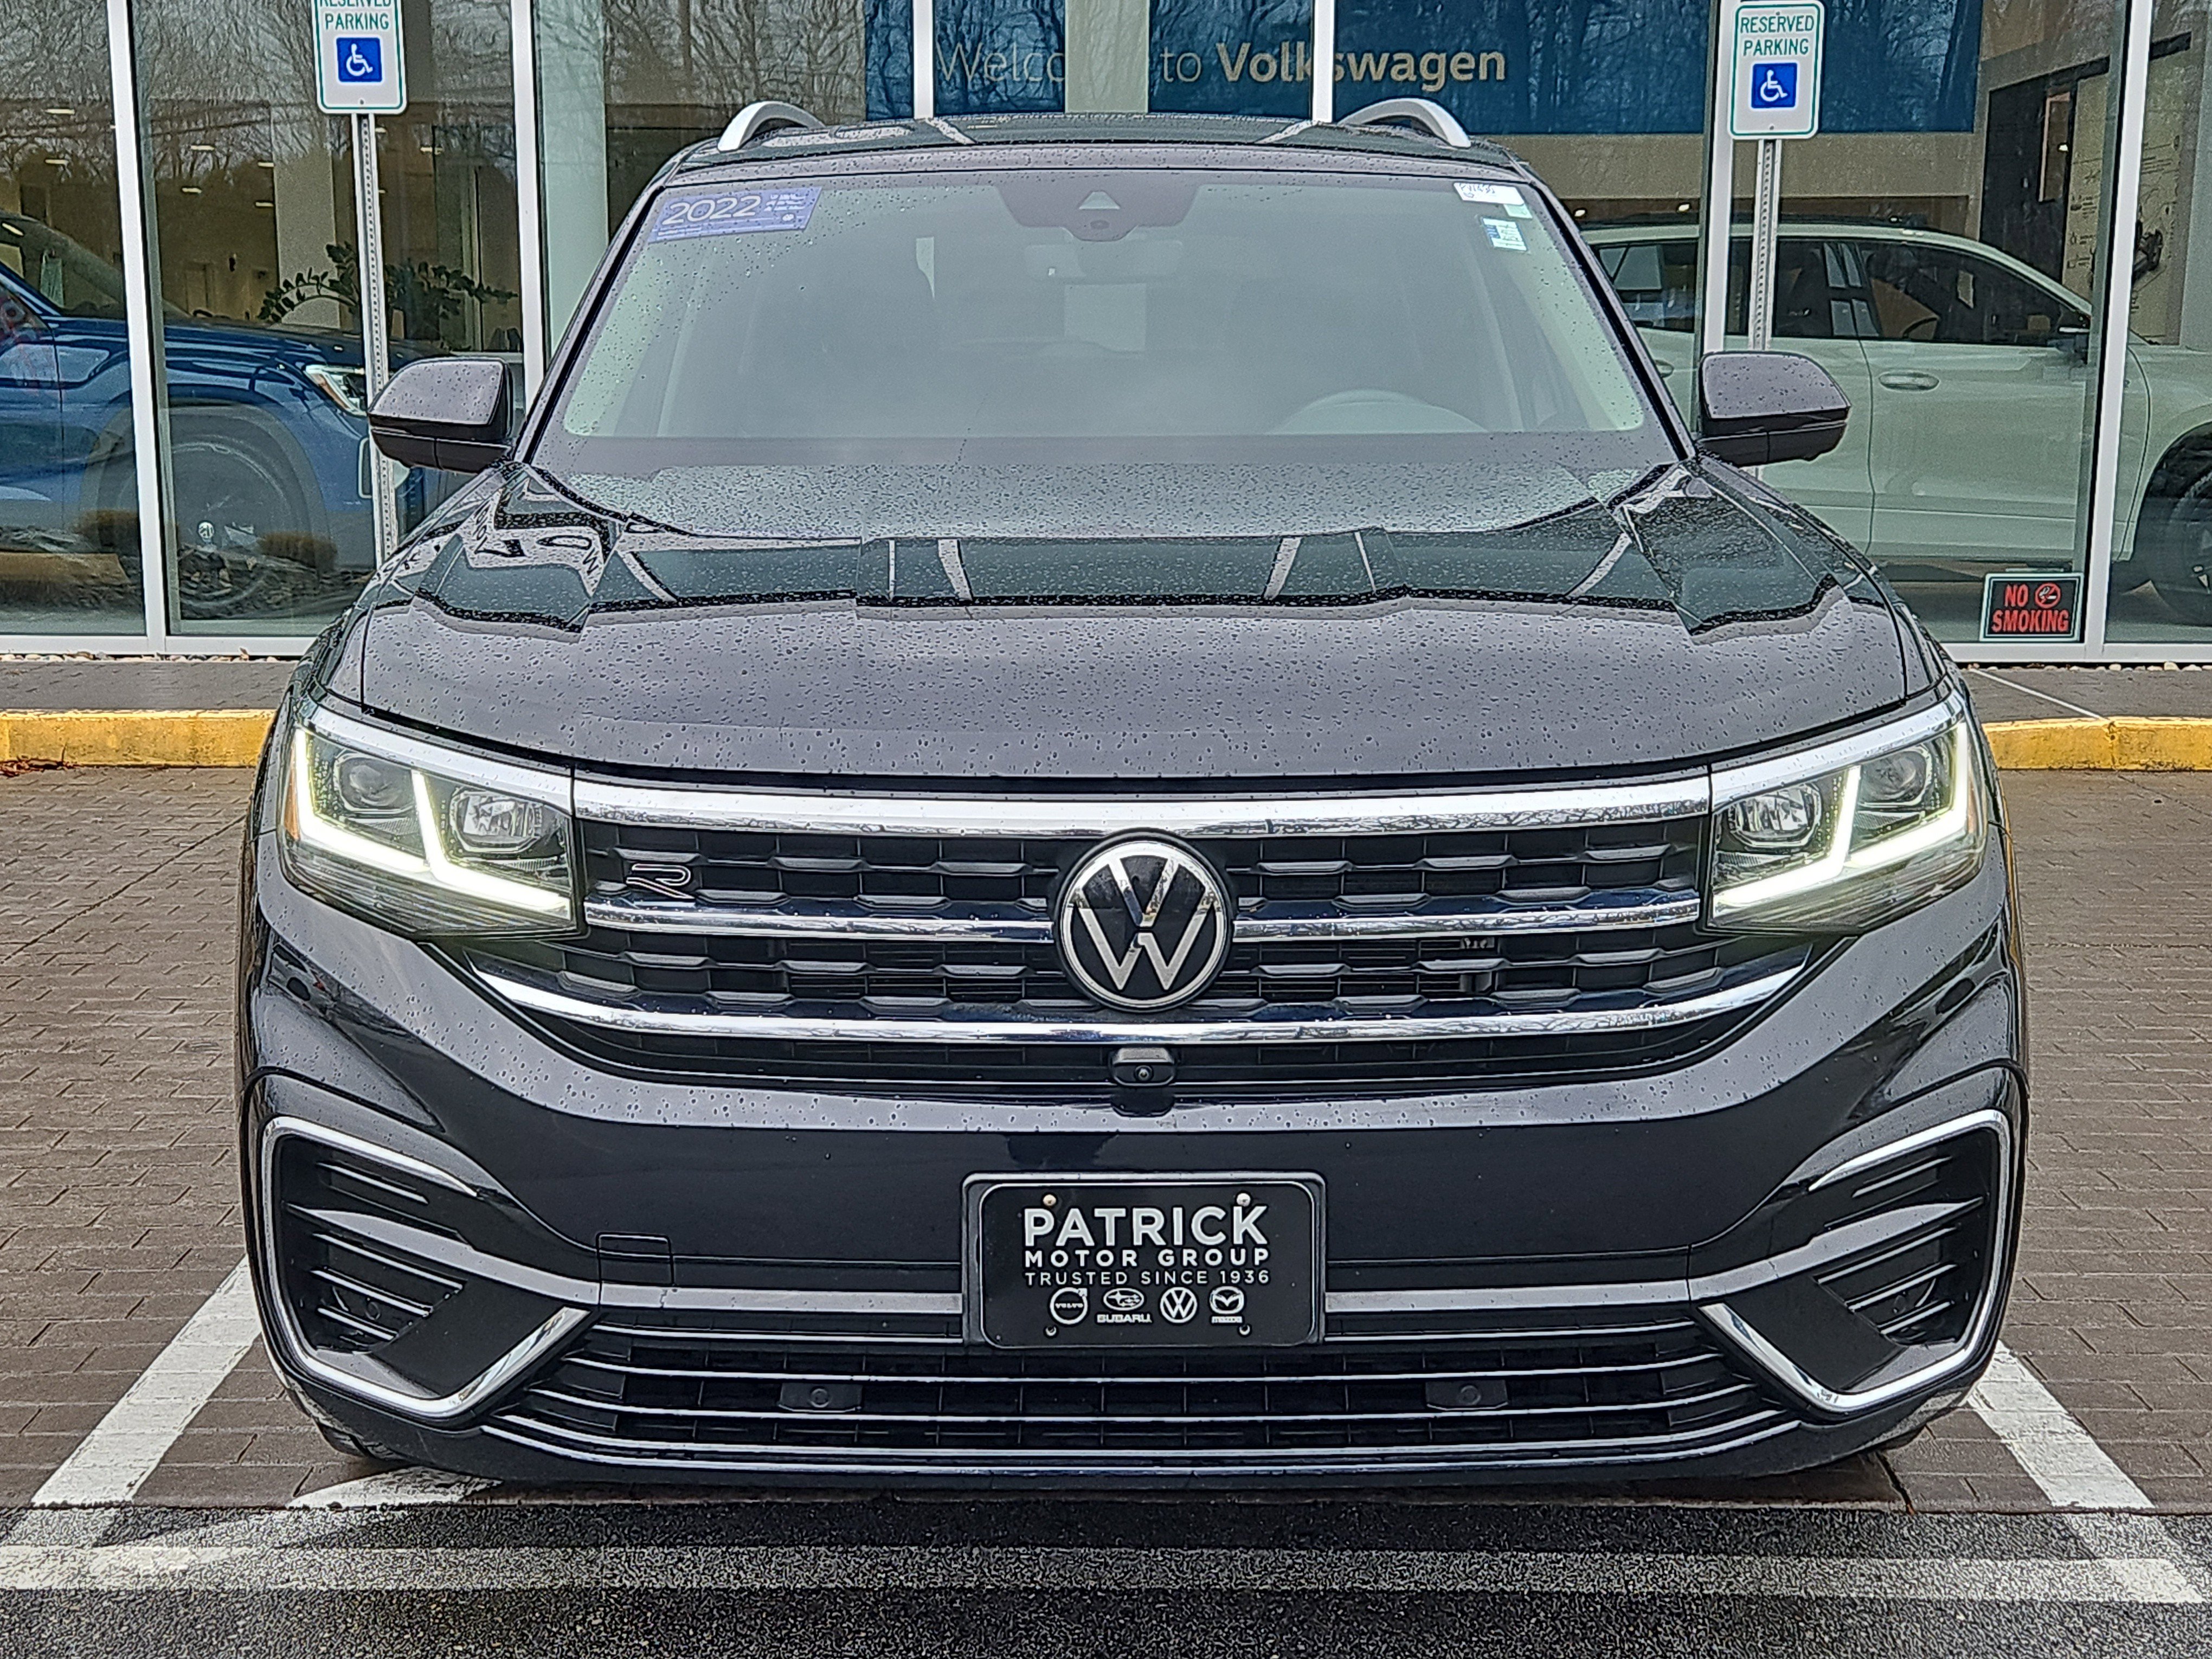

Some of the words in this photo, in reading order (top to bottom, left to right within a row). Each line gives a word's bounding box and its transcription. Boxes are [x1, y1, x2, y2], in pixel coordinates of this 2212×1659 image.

[325, 12, 389, 30] PARKING
[1740, 15, 1815, 33] RESERVED
[1743, 38, 1809, 56] PARKING
[1160, 47, 1201, 82] to
[662, 195, 761, 225] 2022
[2004, 583, 2029, 607] NO
[1991, 609, 2070, 633] SMOKING
[1024, 1206, 1268, 1246] PATRICK
[1025, 1249, 1137, 1268] MOTOR
[1158, 1248, 1270, 1267] GROUP
[1025, 1272, 1128, 1286] TRUSTED
[1141, 1271, 1208, 1285] SINCE
[1220, 1270, 1270, 1284] 1936
[1096, 1313, 1153, 1323] SUBARU
